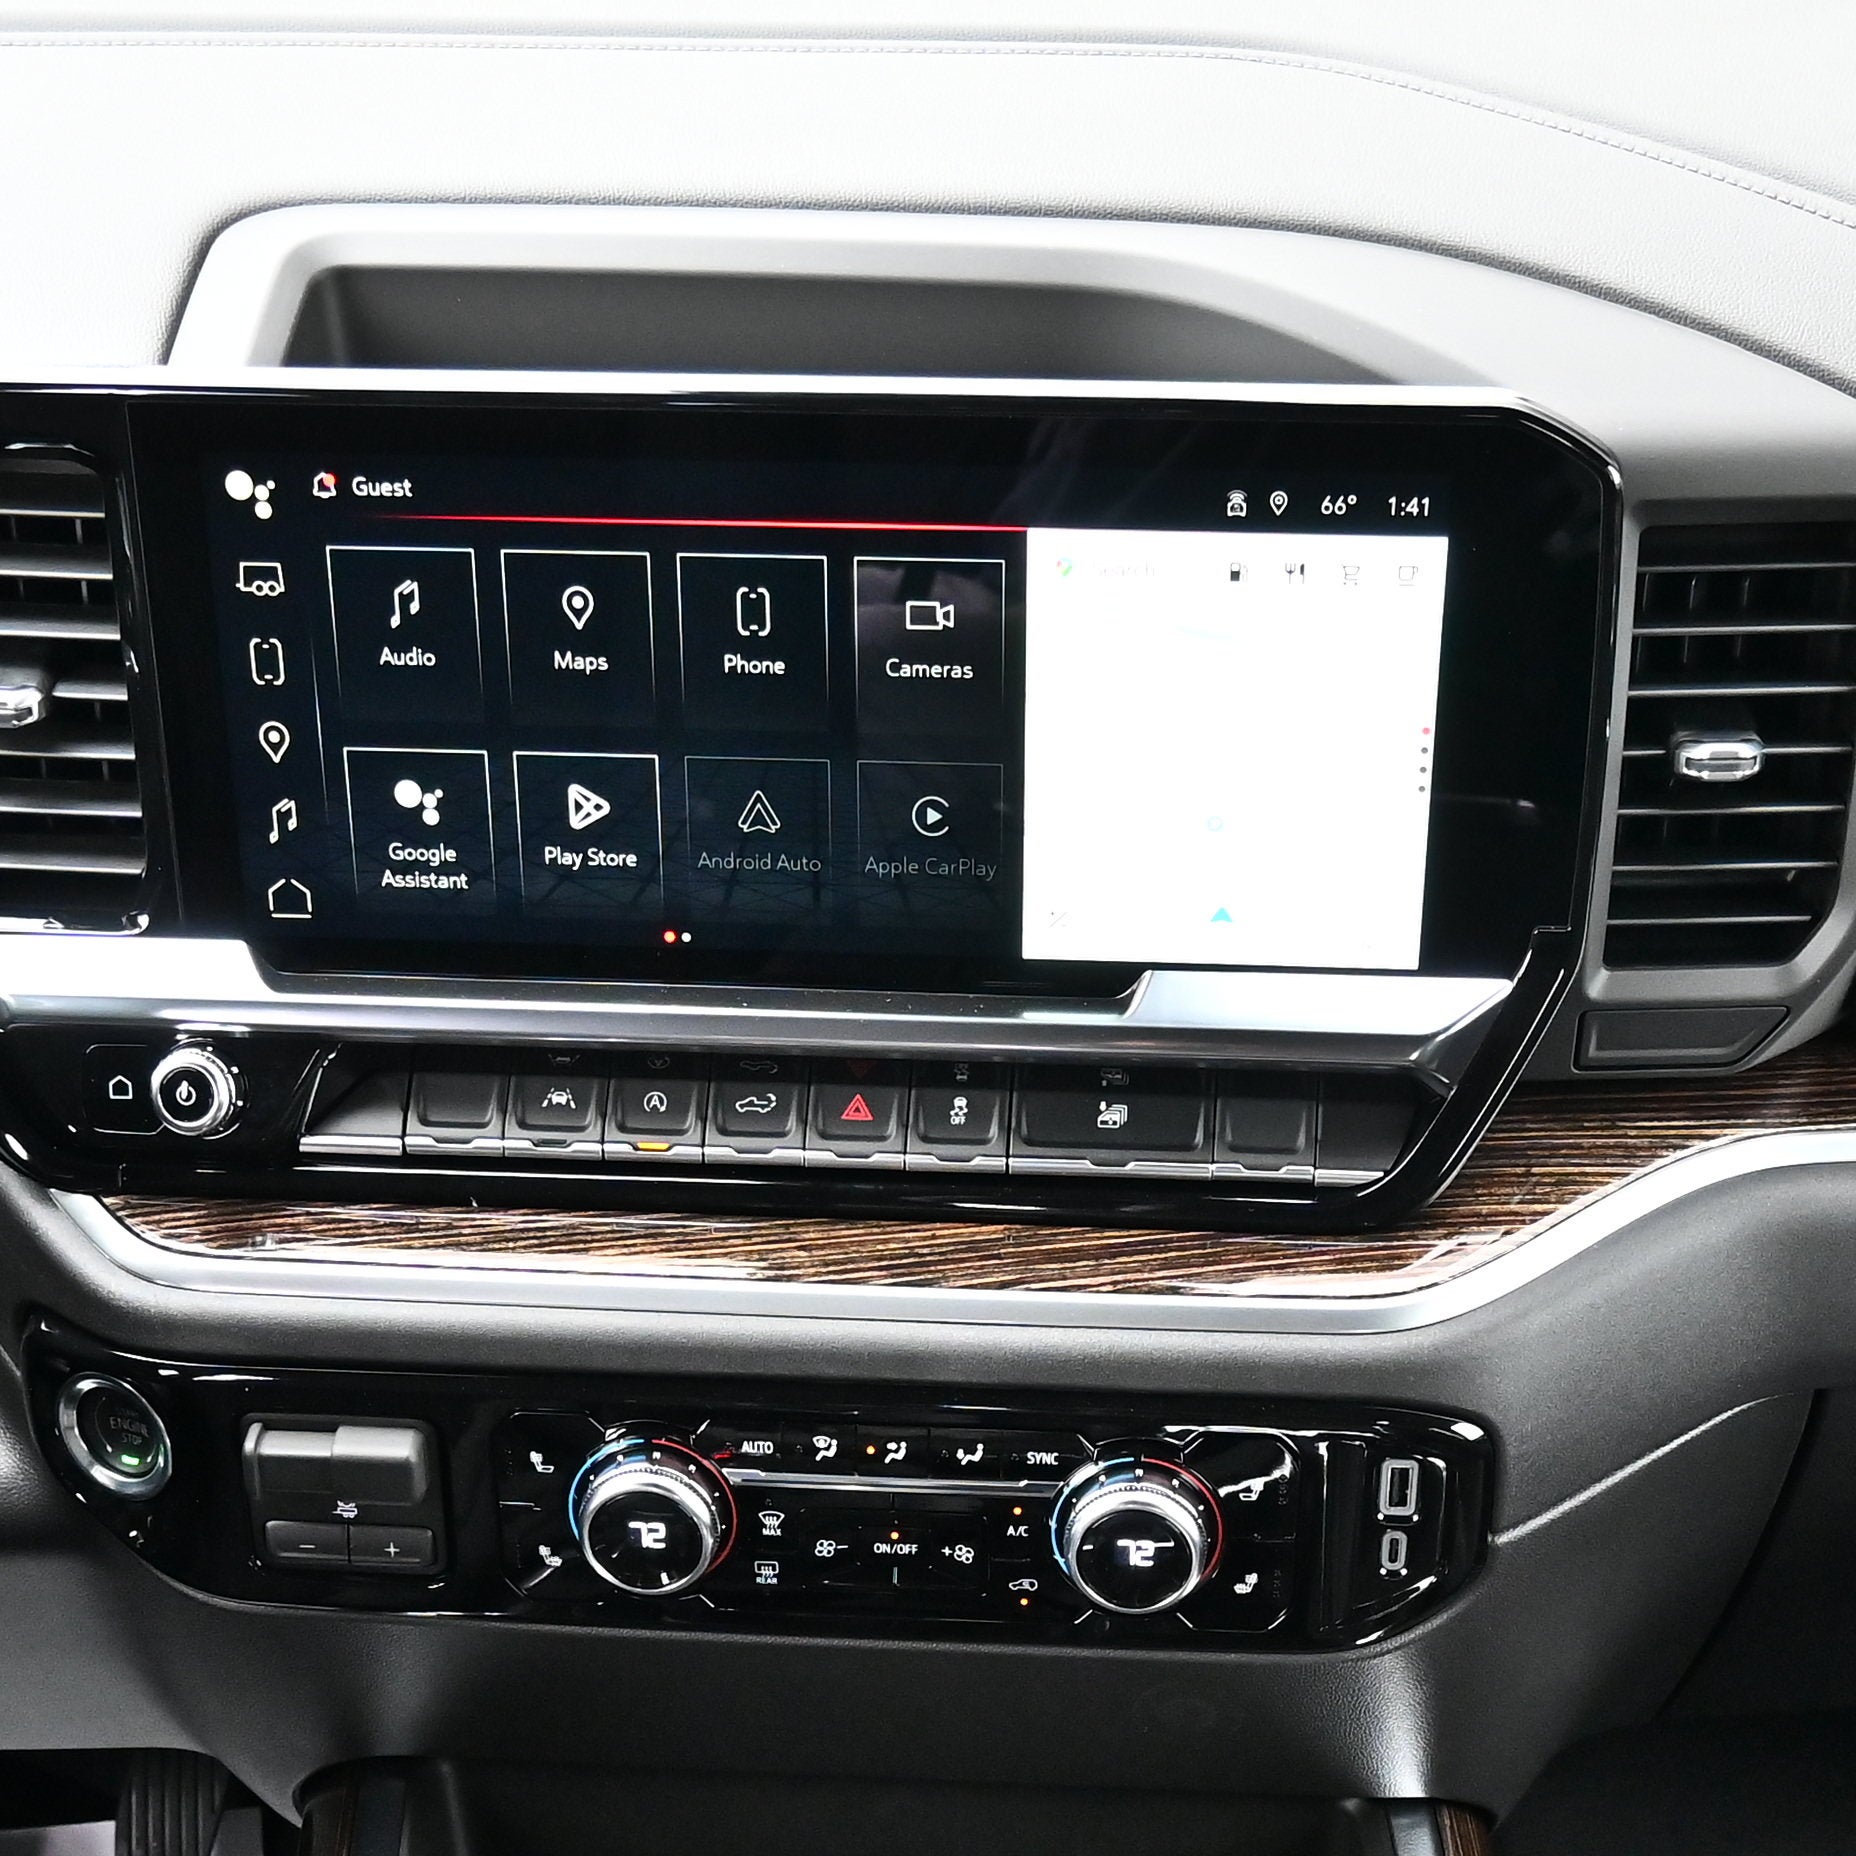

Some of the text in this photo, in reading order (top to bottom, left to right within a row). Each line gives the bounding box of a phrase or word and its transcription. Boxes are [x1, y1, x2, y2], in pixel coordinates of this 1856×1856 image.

[351, 475, 414, 499] Guest
[1387, 495, 1431, 517] 1:41
[378, 645, 437, 668] Audio
[553, 650, 610, 676] Maps
[723, 653, 787, 676] Phone
[884, 657, 975, 680] Cameras
[387, 841, 458, 867] Google
[543, 845, 639, 872] Play Store
[697, 850, 822, 873] Android Auto
[380, 868, 470, 890] Assistant
[863, 855, 998, 882] Apple CarPlay
[949, 1115, 967, 1126] OFF
[740, 1440, 775, 1456] AUTO
[1025, 1450, 1060, 1466] SYNC
[627, 1520, 667, 1550] 72
[761, 1527, 783, 1537] MAX
[1006, 1525, 1030, 1538] A/C
[872, 1542, 919, 1556] ON/OFF
[1115, 1538, 1155, 1568] 72
[755, 1575, 779, 1585] REAR
